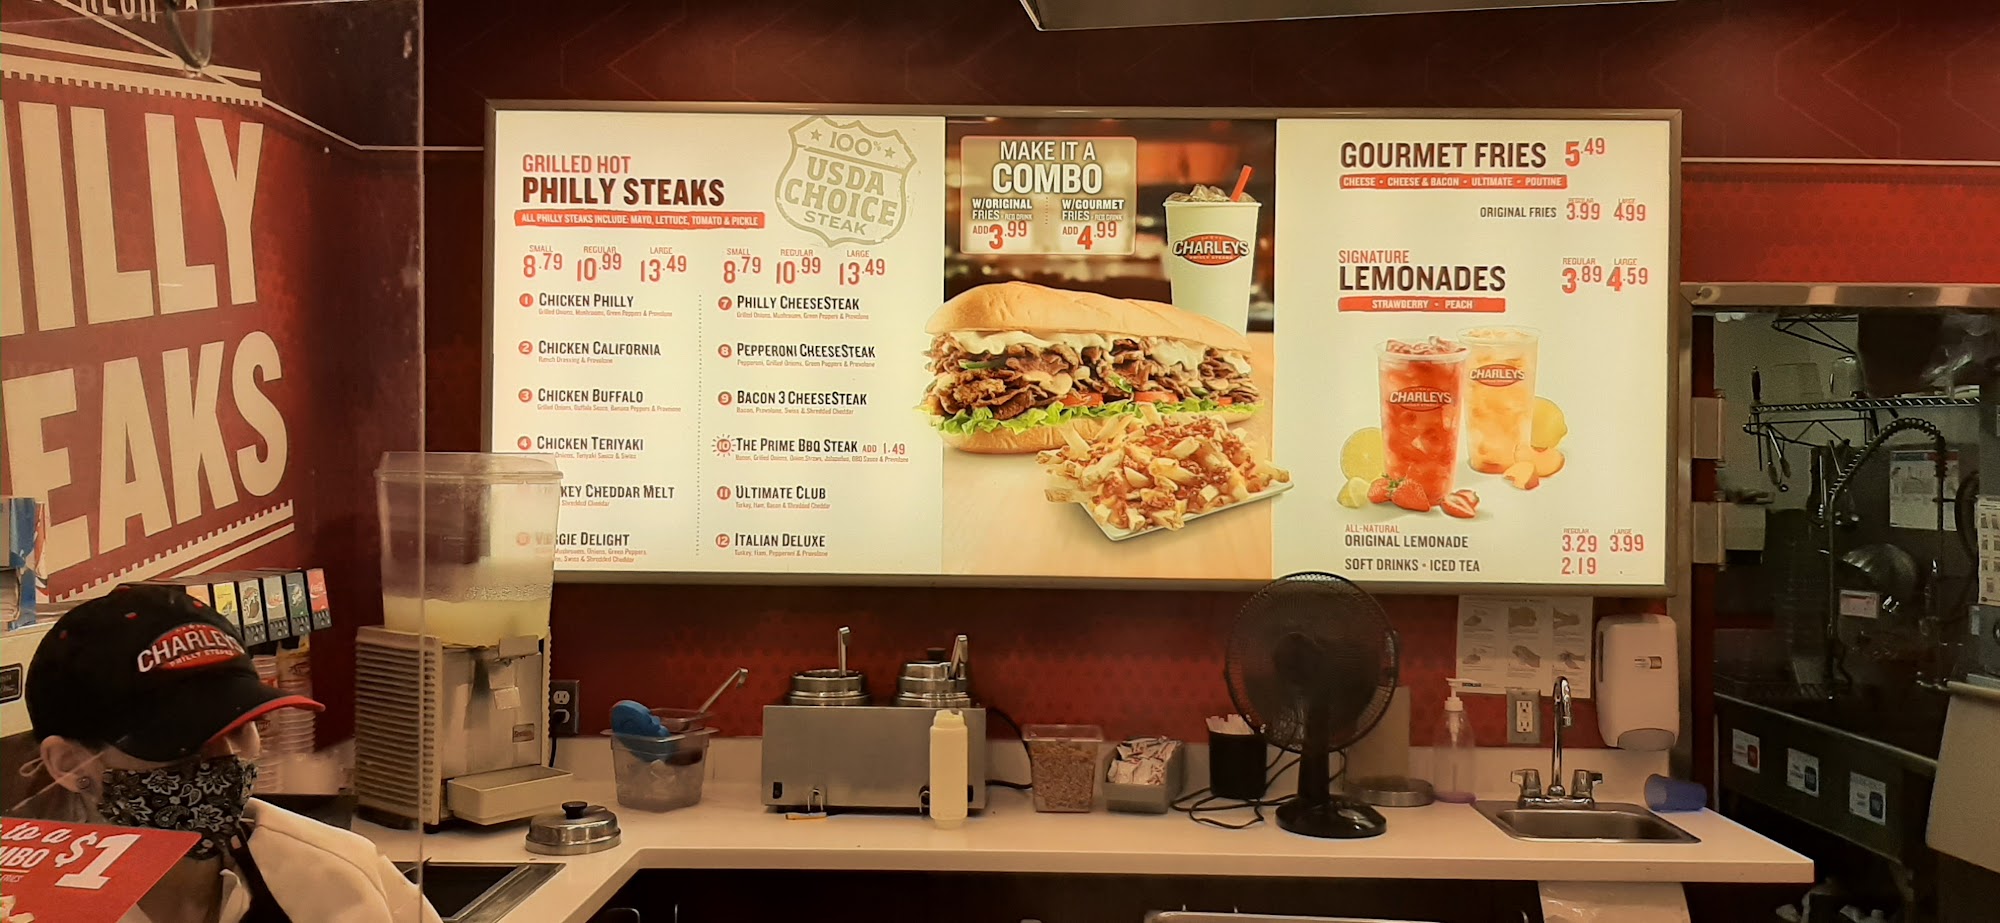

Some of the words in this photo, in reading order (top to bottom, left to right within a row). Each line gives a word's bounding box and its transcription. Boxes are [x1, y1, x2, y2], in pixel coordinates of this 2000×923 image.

[830, 132, 881, 156] 100%
[1000, 141, 1055, 160] MAKE
[1061, 141, 1079, 160] IT
[1084, 141, 1096, 160] A
[1340, 142, 1467, 168] GOURMET
[1475, 142, 1547, 168] FRIES
[1564, 137, 1606, 167] 5.49
[523, 154, 591, 173] GRILLED
[597, 156, 631, 173] HOT
[807, 156, 884, 195] USDA
[992, 163, 1103, 194] COMBO
[1343, 177, 1376, 187] CHEESE
[1387, 177, 1421, 187] CHEESE
[1422, 177, 1429, 187] &
[1430, 177, 1459, 187] BACON
[1471, 177, 1513, 187] ULTIMATE
[1525, 177, 1562, 187] POUTINE
[522, 177, 616, 204] PHILLY
[623, 178, 724, 206] STEAKS
[785, 179, 898, 226] CHOICE
[972, 198, 1033, 209] W/ORIGINAL
[1062, 199, 1124, 210] W/GOURMET
[972, 210, 1000, 220] FRIES
[1062, 210, 1090, 221] FRIES
[1480, 207, 1526, 218] ORIGINAL
[1530, 207, 1557, 218] FRIES
[1566, 203, 1600, 220] 3.99
[522, 214, 535, 222] ALL
[537, 214, 563, 223] PHILLY
[565, 215, 593, 223] STEAKS
[595, 215, 628, 224] INCLUDE:
[631, 215, 654, 225] MAYO,
[655, 216, 690, 225] LETTUCE,
[692, 216, 722, 225] TOMATO
[725, 217, 729, 225] &
[732, 217, 758, 226] PICKLE
[804, 211, 867, 235] STEAK
[973, 226, 988, 234] ADD
[988, 221, 1027, 250] 3.99
[1062, 226, 1078, 235] ADD
[1077, 221, 1117, 250] 4.99
[529, 245, 554, 253] SMALL
[583, 246, 616, 254] REGULAR
[650, 247, 673, 255] LARGE
[847, 250, 870, 258] LARGE
[1173, 240, 1250, 256] CHARLEYS
[1338, 250, 1410, 264] SIGNATURE
[523, 253, 563, 278] 8.79
[576, 254, 622, 282] 10.99
[640, 255, 687, 282] 13.49
[723, 257, 761, 284] 8.79
[776, 257, 821, 284] 10.99
[839, 258, 885, 285] 13.49
[1339, 265, 1506, 291] LEMONADES
[1562, 266, 1602, 294] 3.89
[1606, 267, 1648, 292] 4.59
[539, 292, 590, 307] CHICKEN
[594, 294, 634, 307] PHILLY
[737, 295, 777, 309] PHILLY
[780, 296, 859, 310] CHEESESTEAK
[1371, 300, 1429, 309] STRAWBERRY
[1445, 300, 1473, 309] PEACH
[538, 340, 589, 354] CHICKEN
[593, 341, 661, 356] CALIFORNIA
[737, 343, 797, 357] PEPPERONI
[800, 344, 876, 358] CHEESESTEAK
[1470, 368, 1525, 380] CHARLEYS
[538, 388, 589, 402] CHICKEN
[592, 389, 643, 403] BUFFALO
[737, 391, 776, 404] BACON
[778, 391, 785, 404] 3
[788, 391, 867, 405] CHEESESTEAK
[1390, 391, 1452, 403] CHARLEYS
[537, 436, 588, 450] CHICKEN
[591, 437, 644, 450] TERIYAKI
[736, 438, 757, 451] THE
[760, 438, 795, 452] PRIME
[800, 439, 820, 452] BBQ
[824, 439, 858, 452] STEAK
[883, 443, 905, 455] 1.49
[586, 484, 640, 498] CHEDDAR
[643, 485, 675, 499] MELT
[736, 486, 793, 499] ULTIMATE
[796, 486, 826, 499] CLUB
[1345, 524, 1400, 533] ALL-NATURAL
[581, 532, 630, 546] DELIGHT
[735, 533, 778, 547] ITALIAN
[782, 533, 825, 547] DELUXE
[1344, 535, 1400, 547] ORIGINAL
[1403, 536, 1469, 548] LEMONADE
[1562, 535, 1597, 552] 3.29
[1609, 534, 1644, 552] 3.99
[1345, 558, 1373, 571] SOFT
[1376, 559, 1419, 571] DRINKS
[1430, 559, 1456, 571] ICED
[1459, 560, 1480, 572] TEA
[1561, 557, 1596, 575] 2.19
[1, 822, 41, 841] to
[41, 829, 72, 844] a
